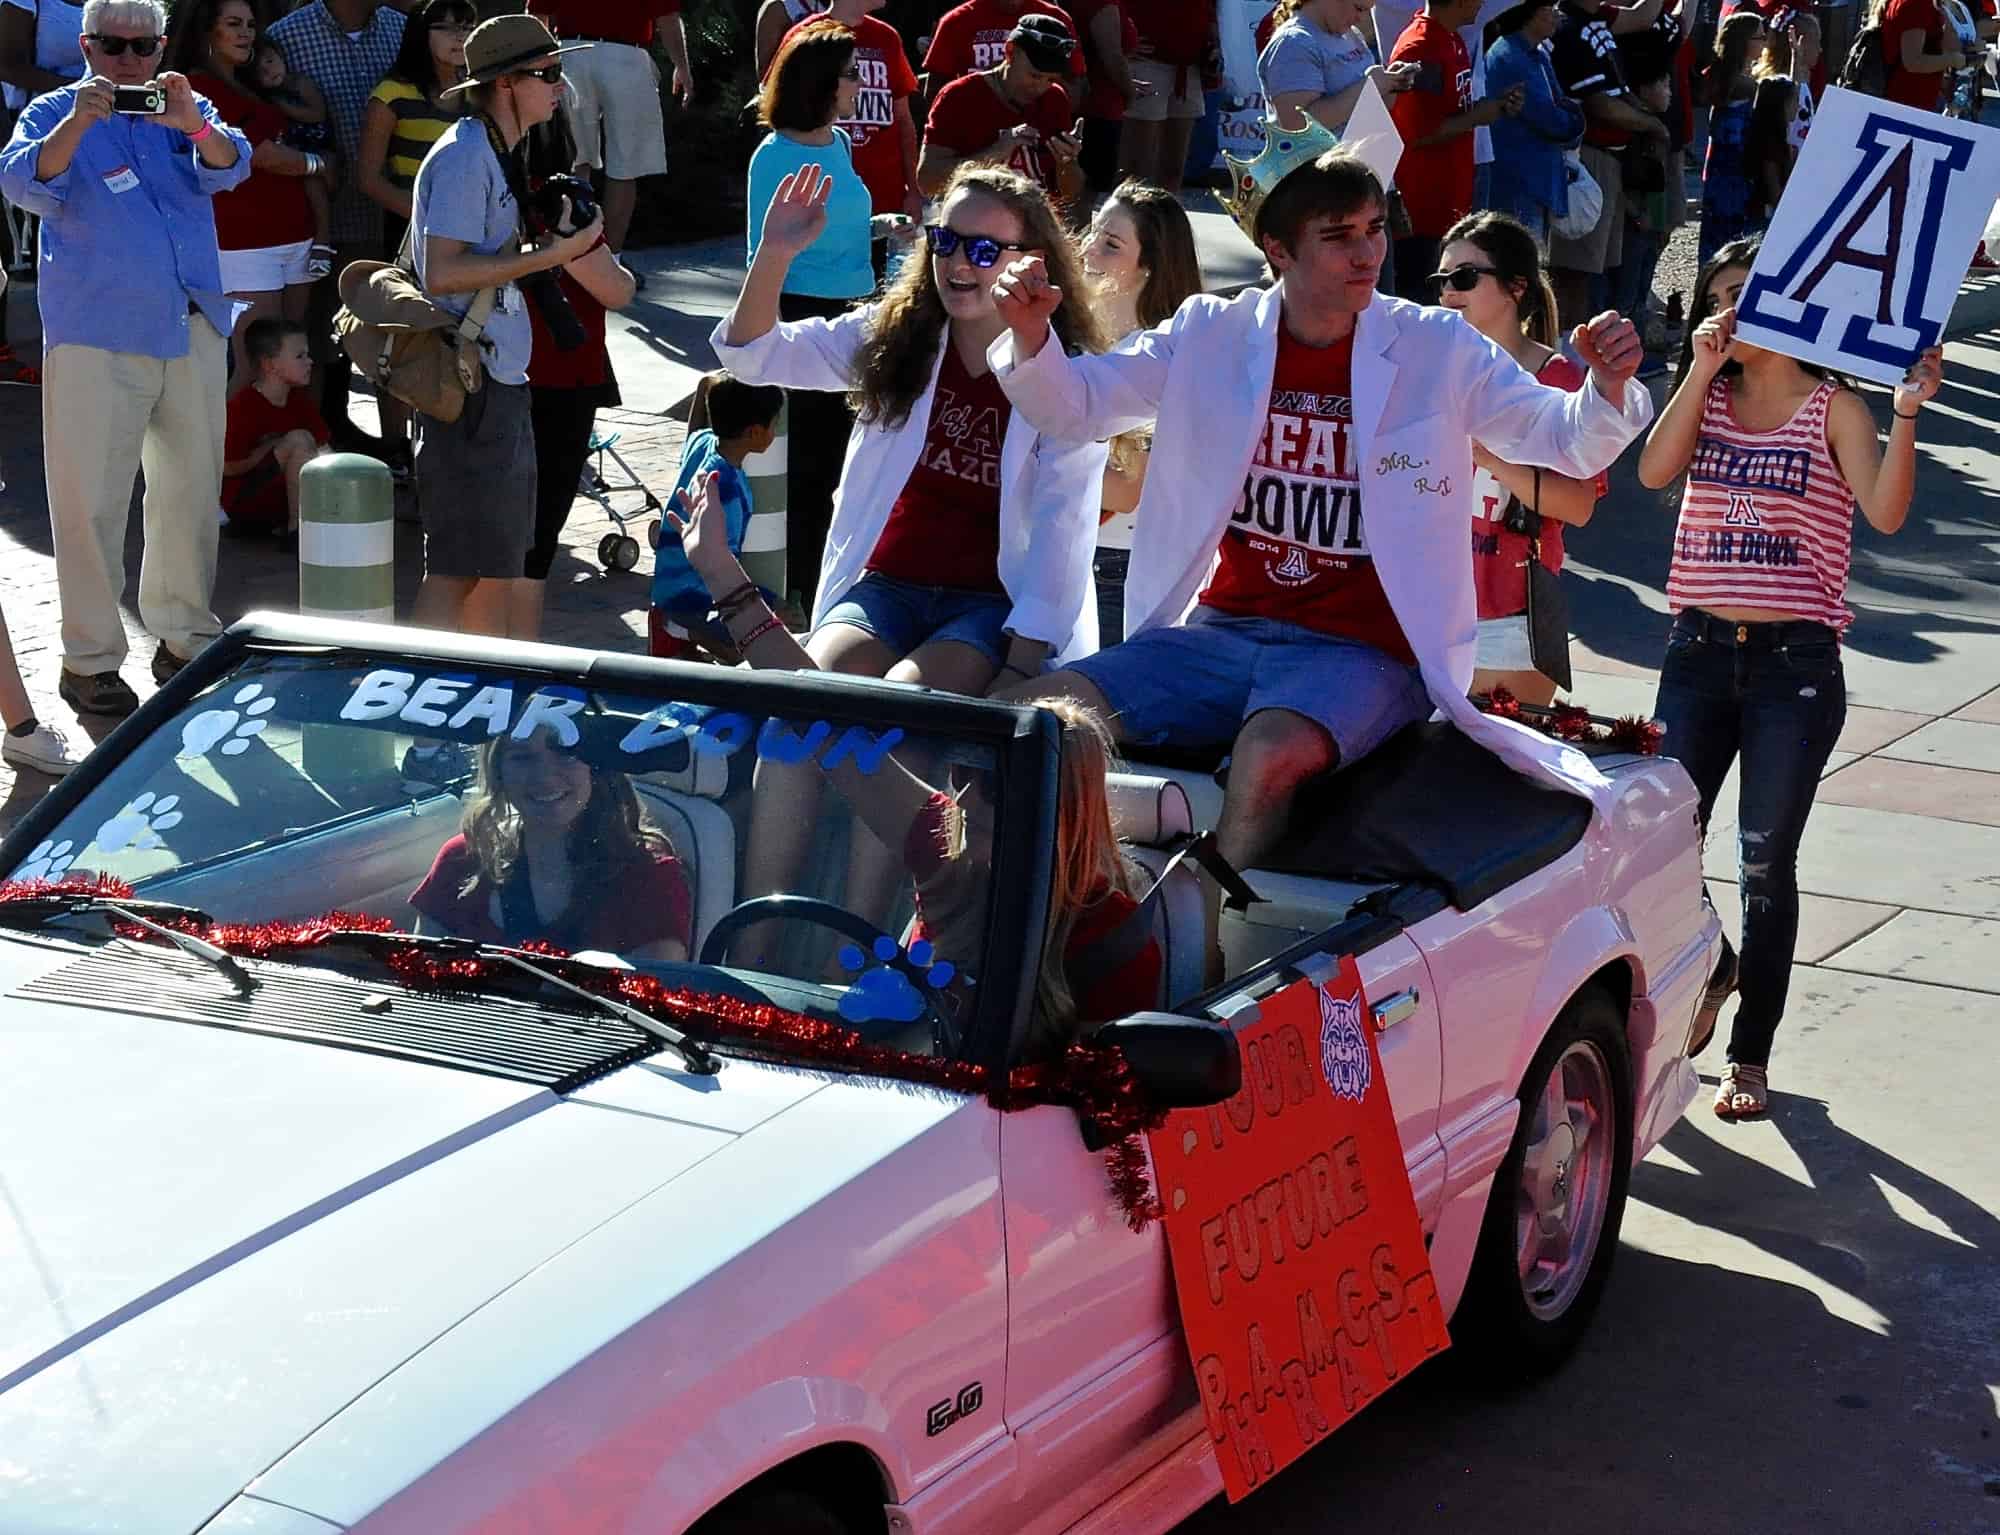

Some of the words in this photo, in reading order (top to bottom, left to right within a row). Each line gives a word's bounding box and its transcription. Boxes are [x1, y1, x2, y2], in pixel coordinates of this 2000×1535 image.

[857, 60, 888, 88] AR
[972, 43, 1005, 67] BE
[856, 90, 890, 121] WN
[1736, 112, 1976, 369] A
[1253, 413, 1359, 480] EA
[1725, 490, 1760, 527] A
[1248, 540, 1280, 554] 2014
[1276, 546, 1311, 579] A
[1741, 534, 1799, 567] DOWN
[340, 668, 586, 748] BEAR
[619, 700, 904, 775] DOWN
[1200, 1135, 1369, 1306] FUTURE
